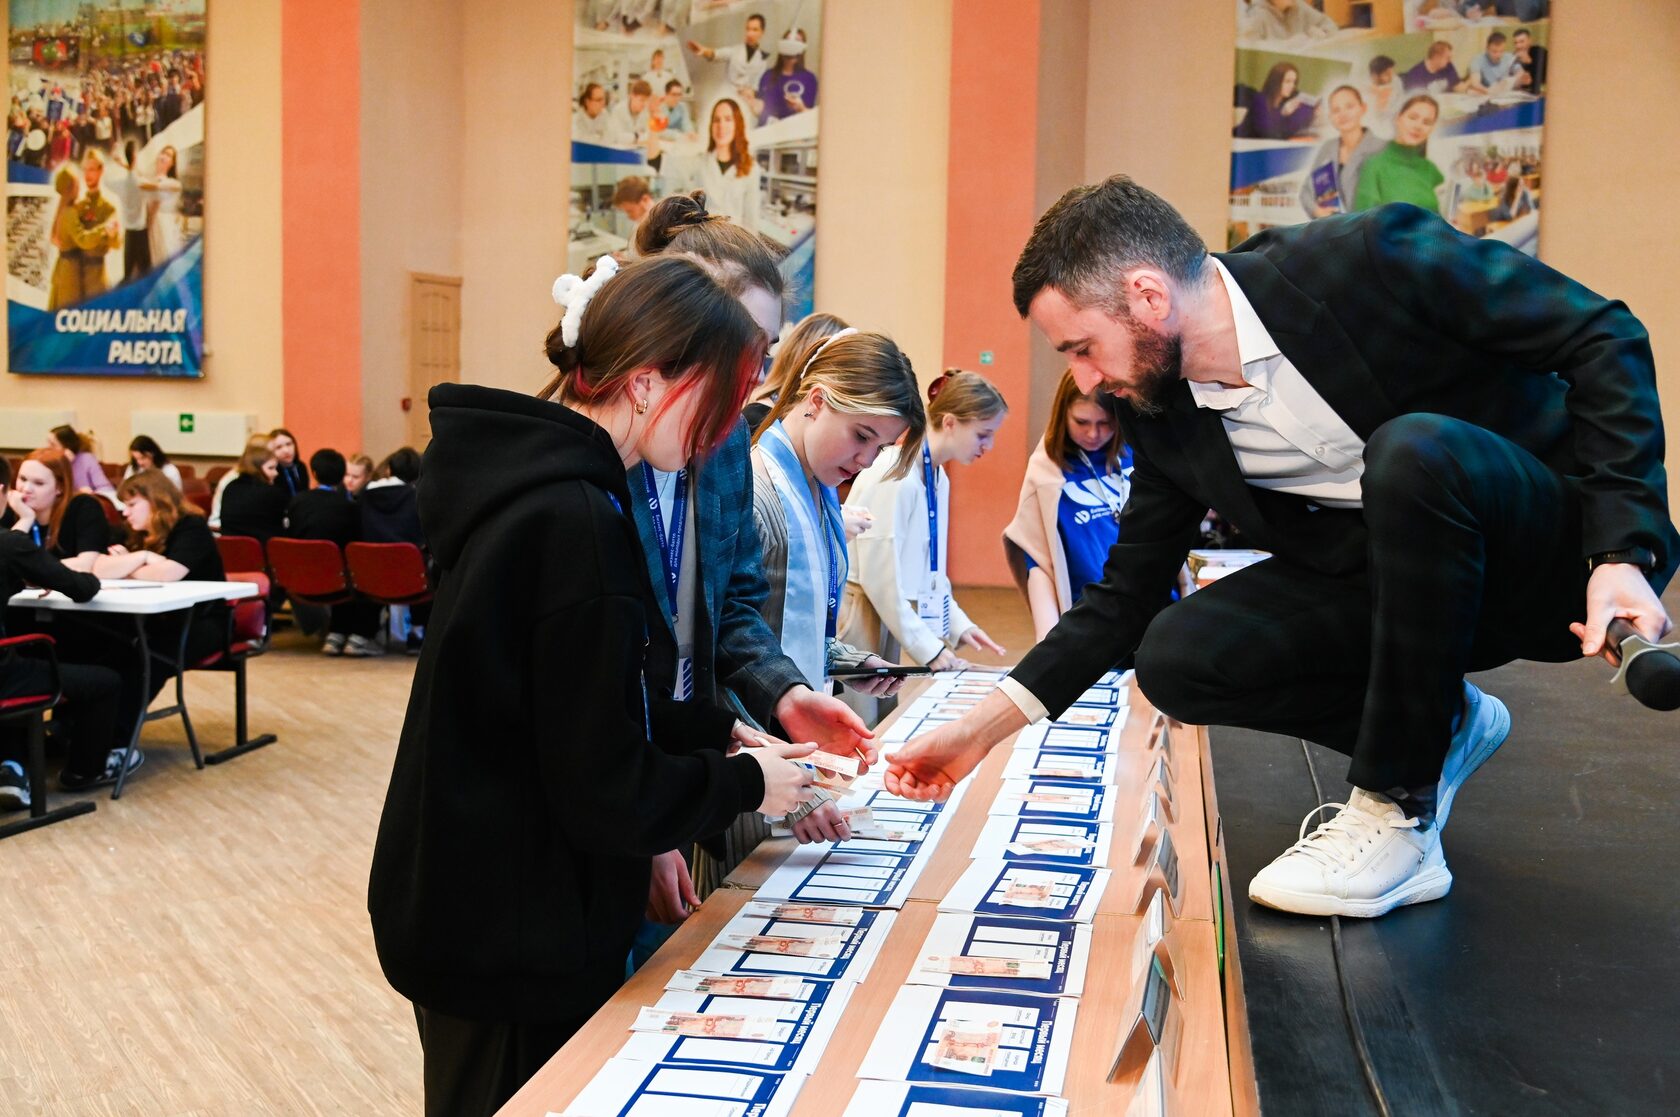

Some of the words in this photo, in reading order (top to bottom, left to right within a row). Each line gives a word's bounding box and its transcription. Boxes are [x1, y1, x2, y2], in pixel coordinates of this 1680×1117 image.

[55, 308, 187, 336] СОЦИАЛЬНАЯ
[107, 340, 183, 365] РАБОТА
[1037, 1020, 1053, 1044] Первый
[745, 1102, 767, 1117] Пер
